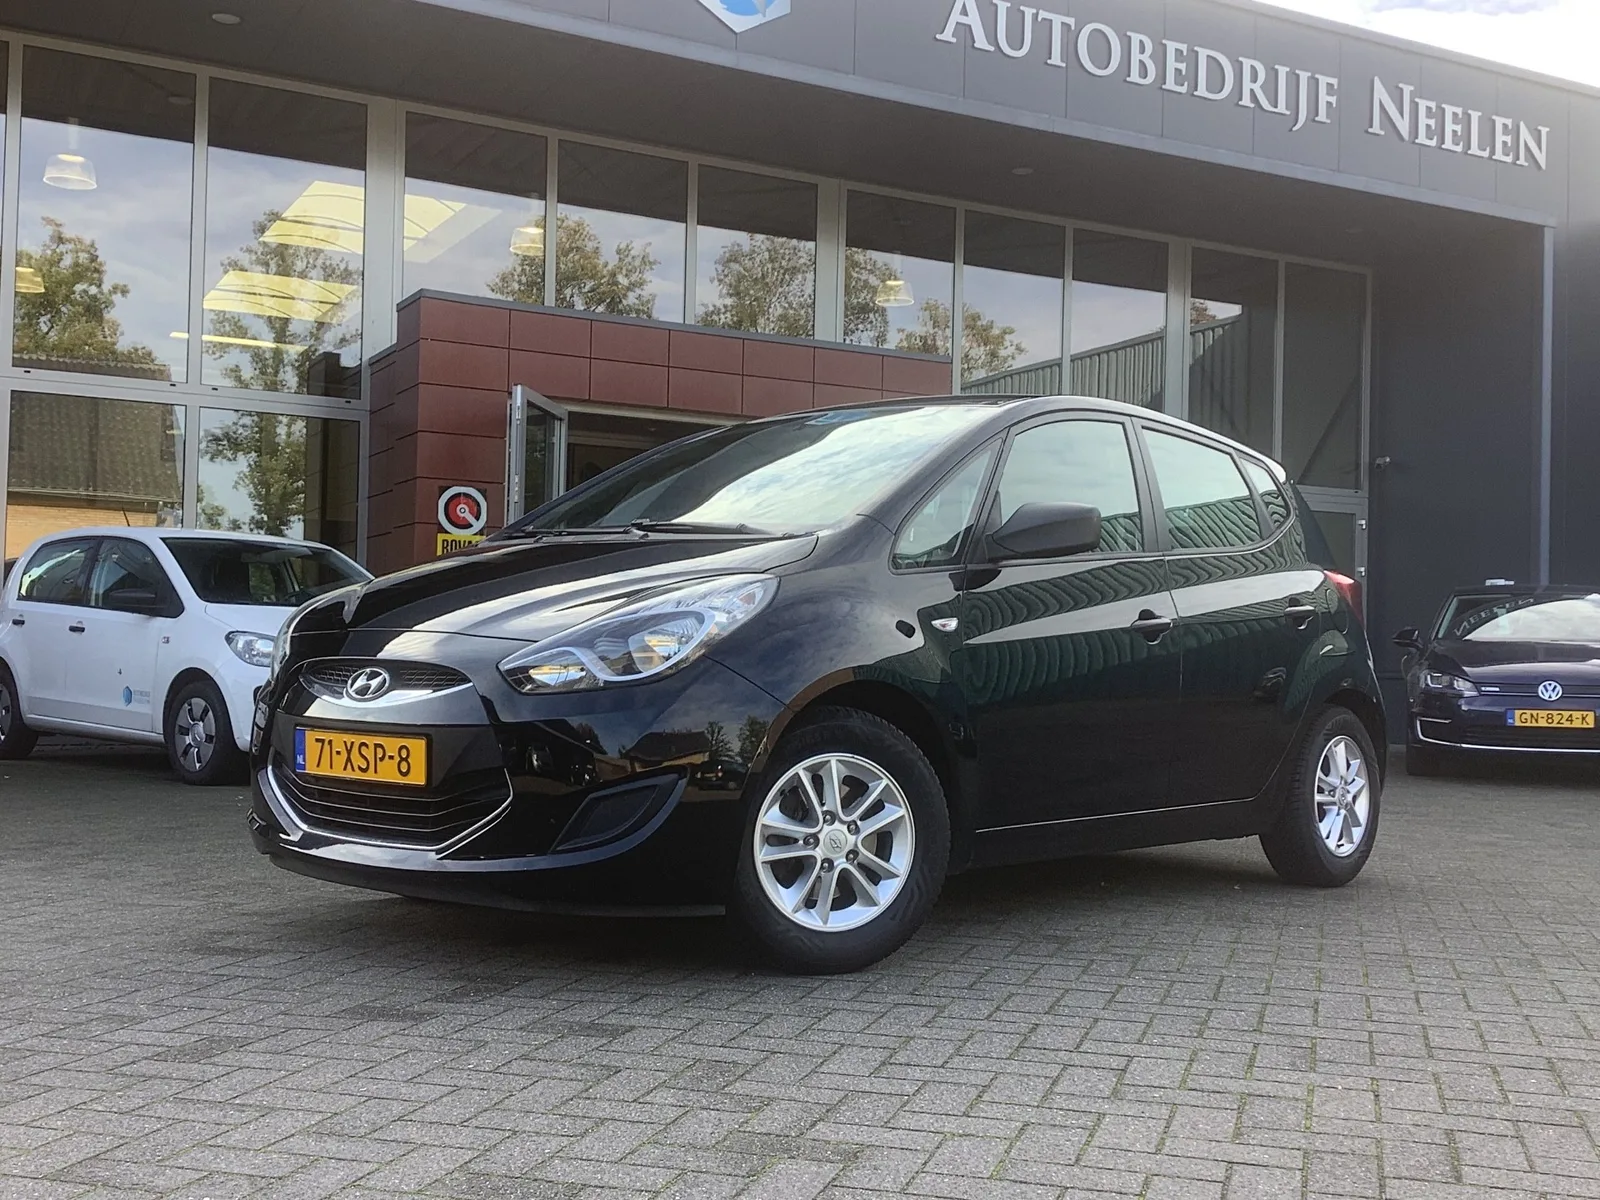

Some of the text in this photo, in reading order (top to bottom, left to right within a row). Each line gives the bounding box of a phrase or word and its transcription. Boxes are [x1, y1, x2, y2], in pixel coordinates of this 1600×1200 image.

[936, 0, 1550, 170] AUTOBEDRIJF NEELEN
[441, 538, 481, 555] BOV
[1519, 711, 1590, 726] GN-824-K
[314, 737, 411, 777] 71-XSP-8
